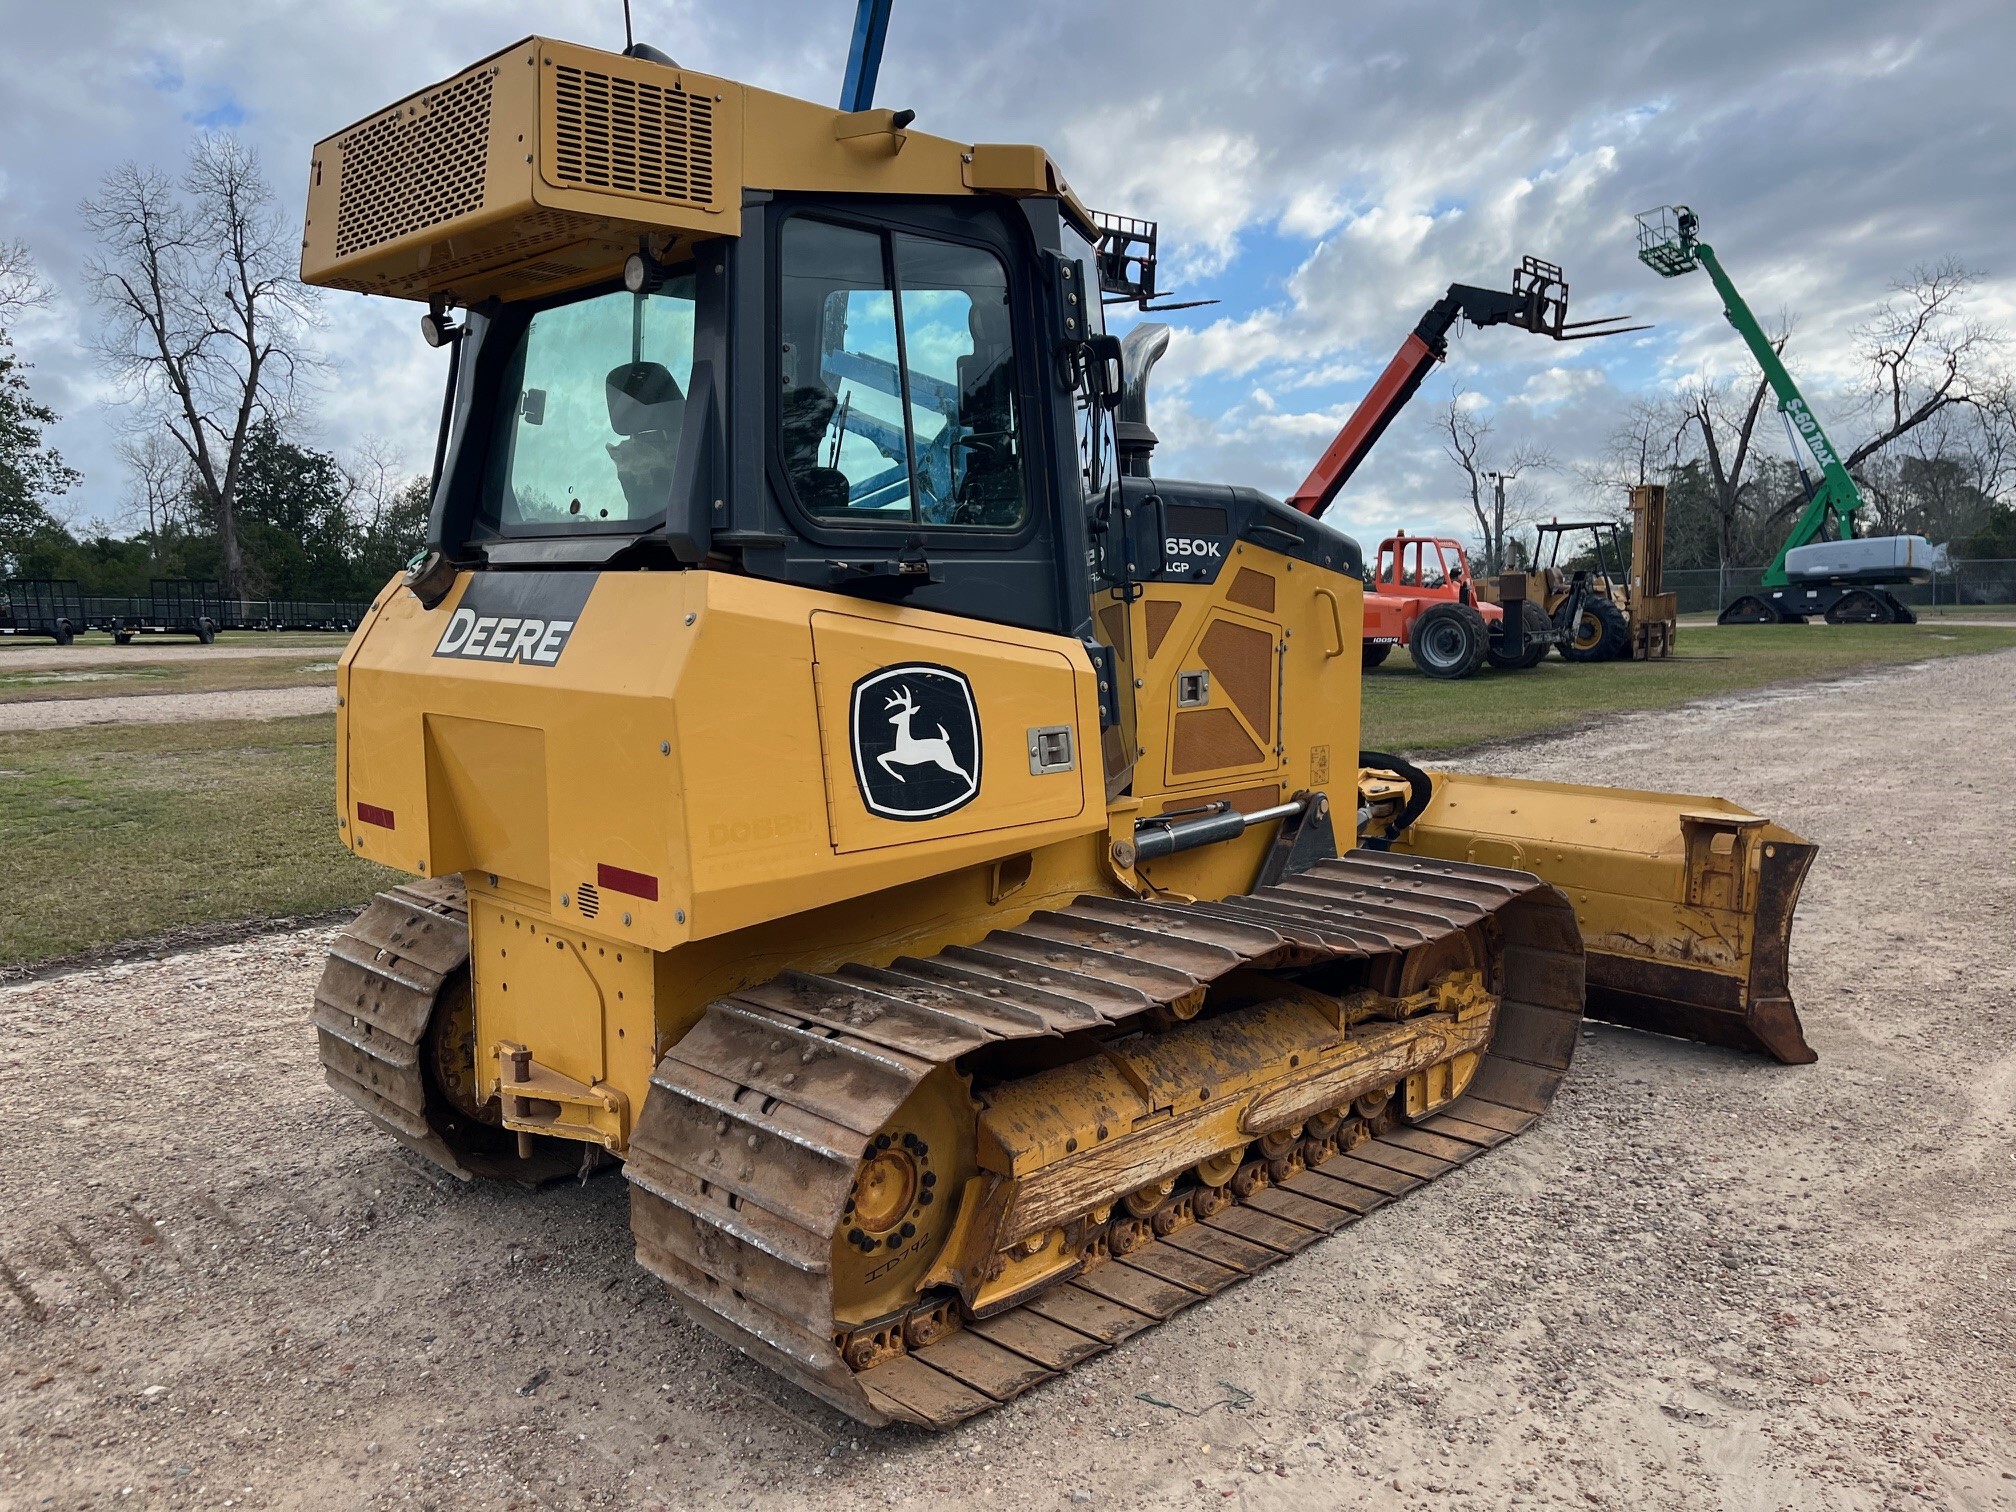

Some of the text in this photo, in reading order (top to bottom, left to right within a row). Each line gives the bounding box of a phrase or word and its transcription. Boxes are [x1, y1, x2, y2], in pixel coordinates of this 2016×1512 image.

[1786, 398, 1835, 467] S-60 TRAX
[1165, 537, 1221, 557] 650K
[1165, 561, 1190, 573] LGP
[437, 608, 574, 662] DEERE
